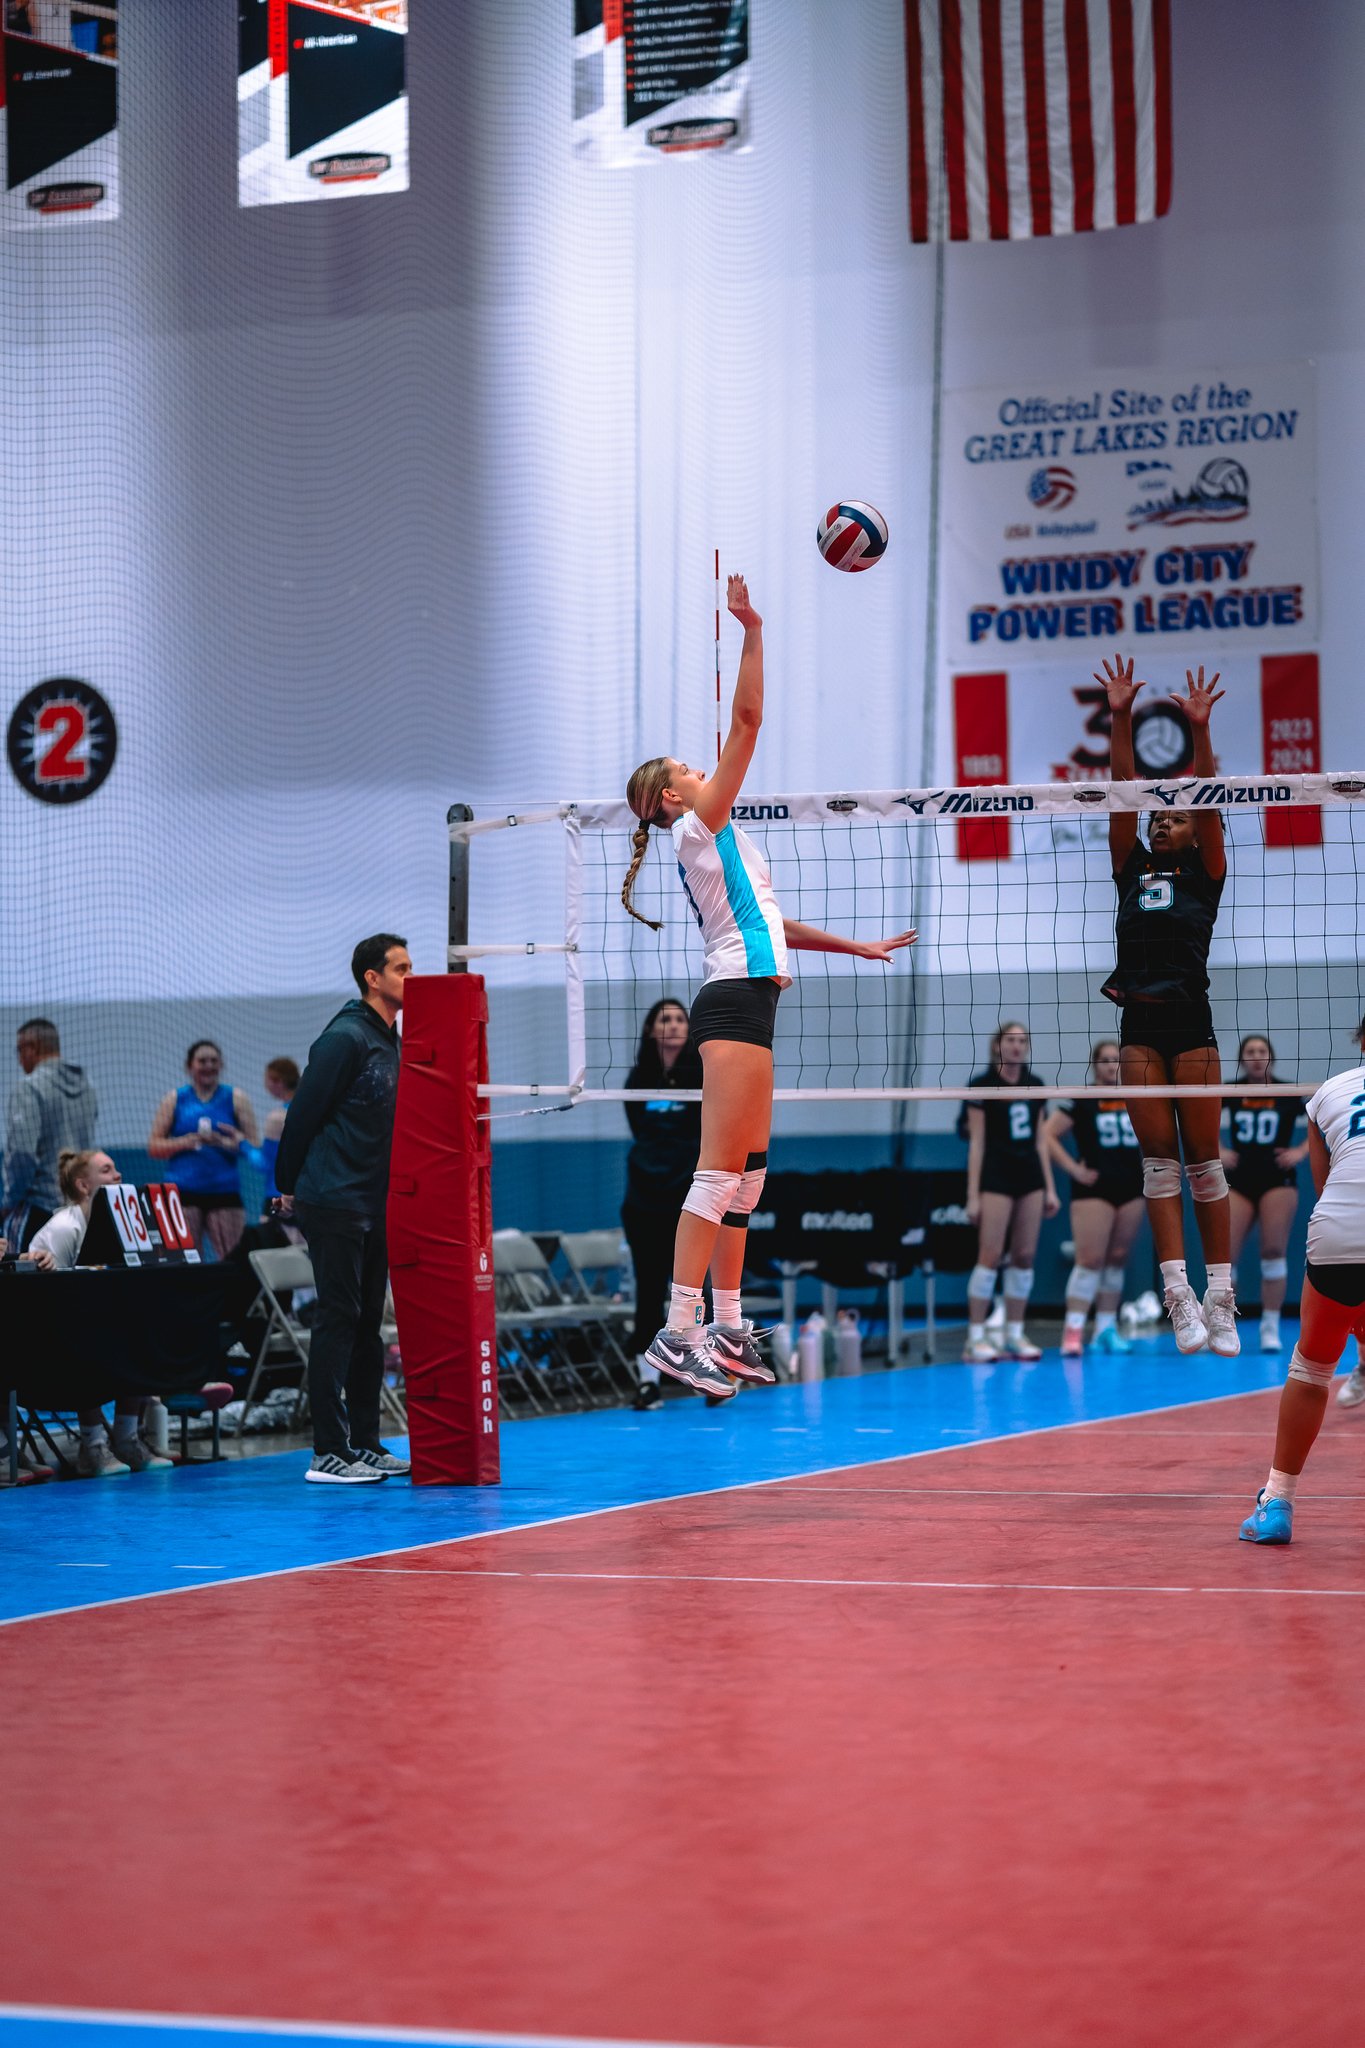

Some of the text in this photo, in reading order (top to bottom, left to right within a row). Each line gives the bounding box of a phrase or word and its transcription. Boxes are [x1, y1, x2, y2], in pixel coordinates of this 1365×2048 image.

[999, 382, 1252, 427] Official Site of the
[965, 410, 1298, 464] GREAT LAKES REGION
[1001, 542, 1256, 595] WINDY CITY
[968, 585, 1303, 643] POWER LEAGUE
[34, 699, 91, 784] 2
[731, 805, 788, 820] izuno
[1139, 873, 1174, 911] 5
[1010, 1102, 1031, 1139] 2
[1235, 1110, 1279, 1143] 30
[114, 1195, 147, 1242] 13
[155, 1190, 187, 1242] 10
[480, 1340, 493, 1433] senoh
